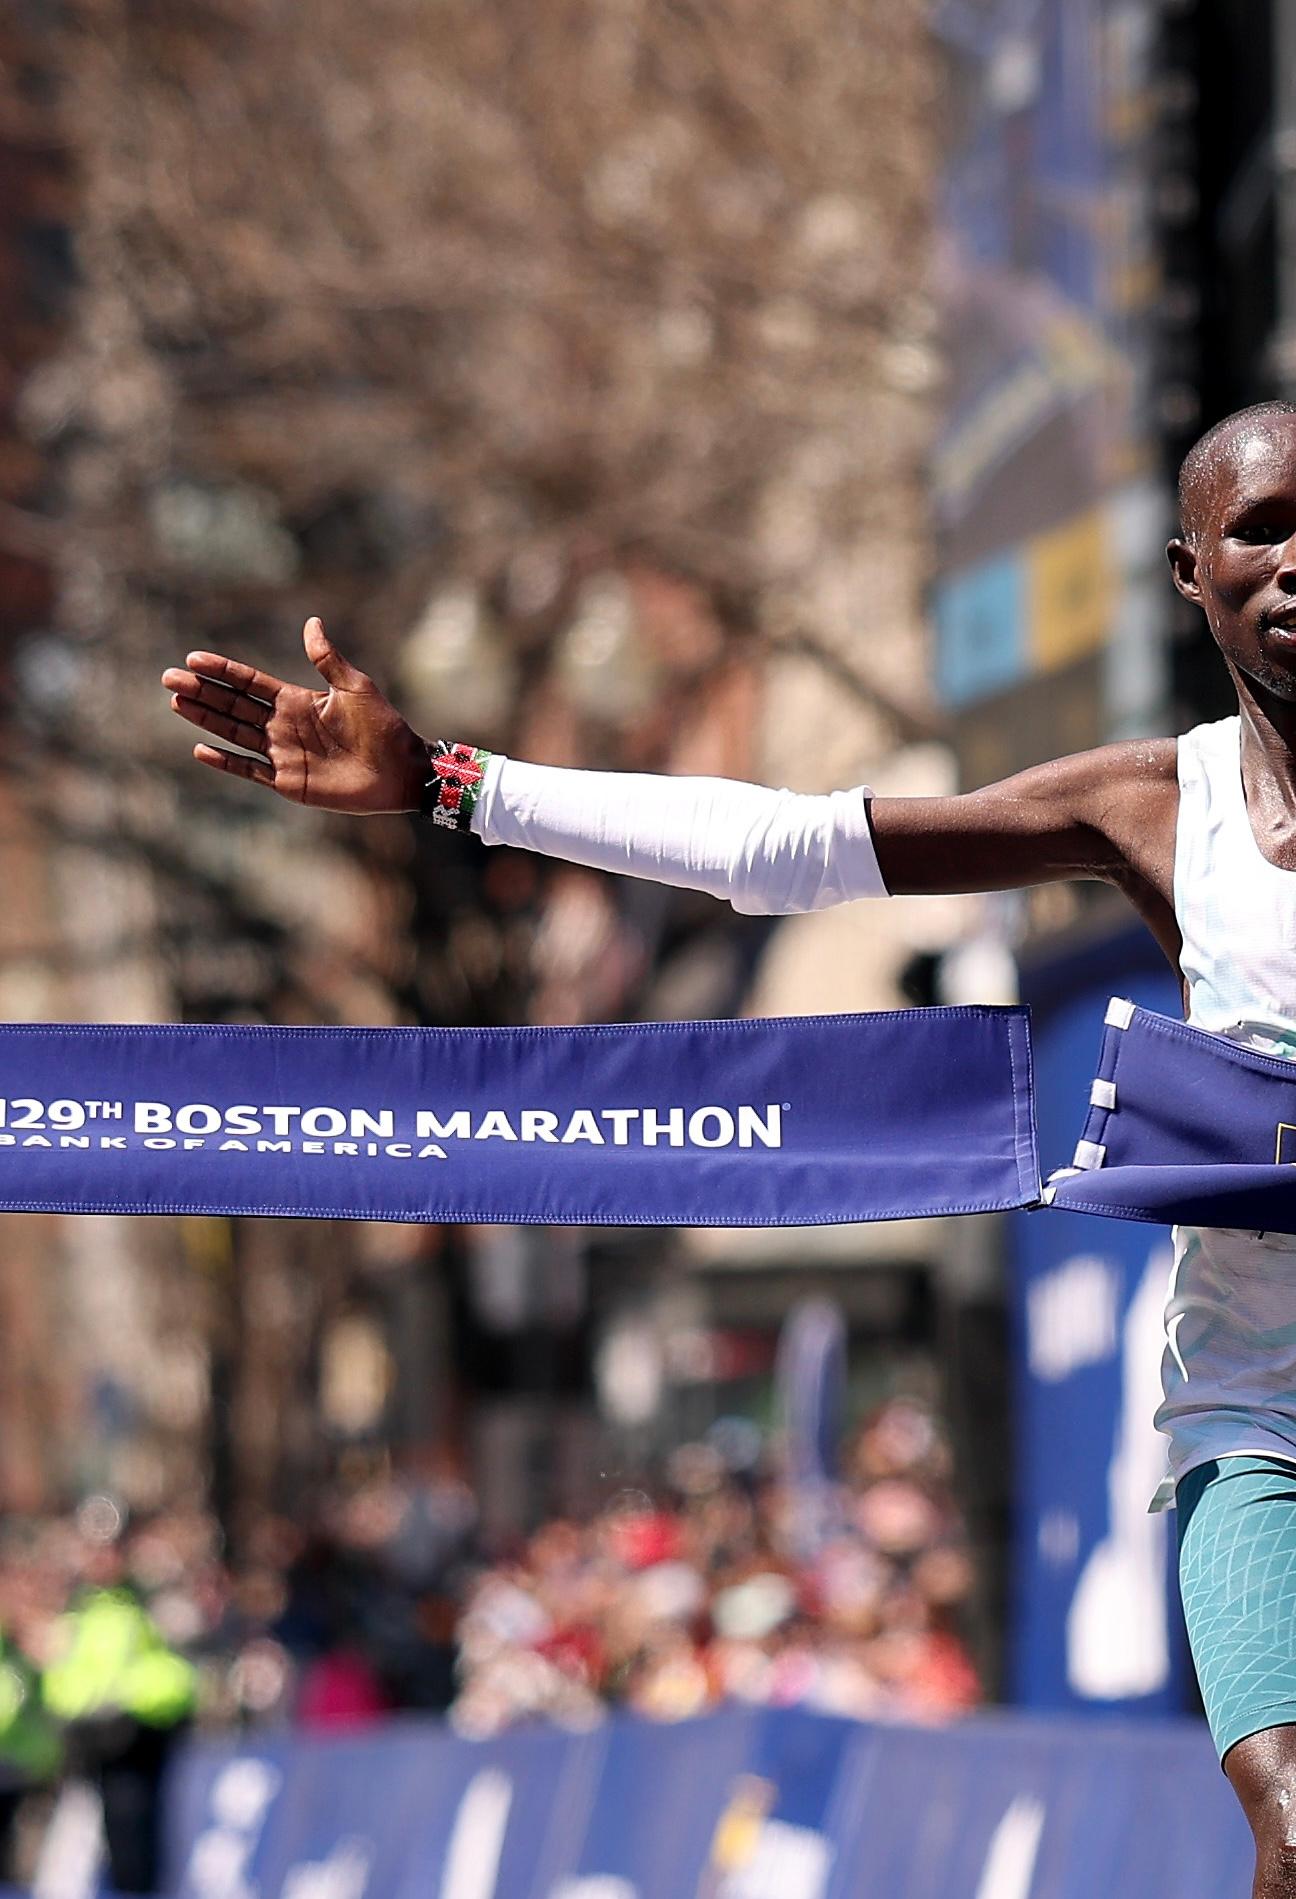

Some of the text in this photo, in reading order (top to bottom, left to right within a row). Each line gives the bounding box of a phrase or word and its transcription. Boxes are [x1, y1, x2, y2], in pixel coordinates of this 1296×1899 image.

[134, 1102, 393, 1137] BOSTON
[416, 1104, 781, 1148] MARATHON
[143, 1137, 205, 1151] OF
[218, 1139, 448, 1159] AMERICA
